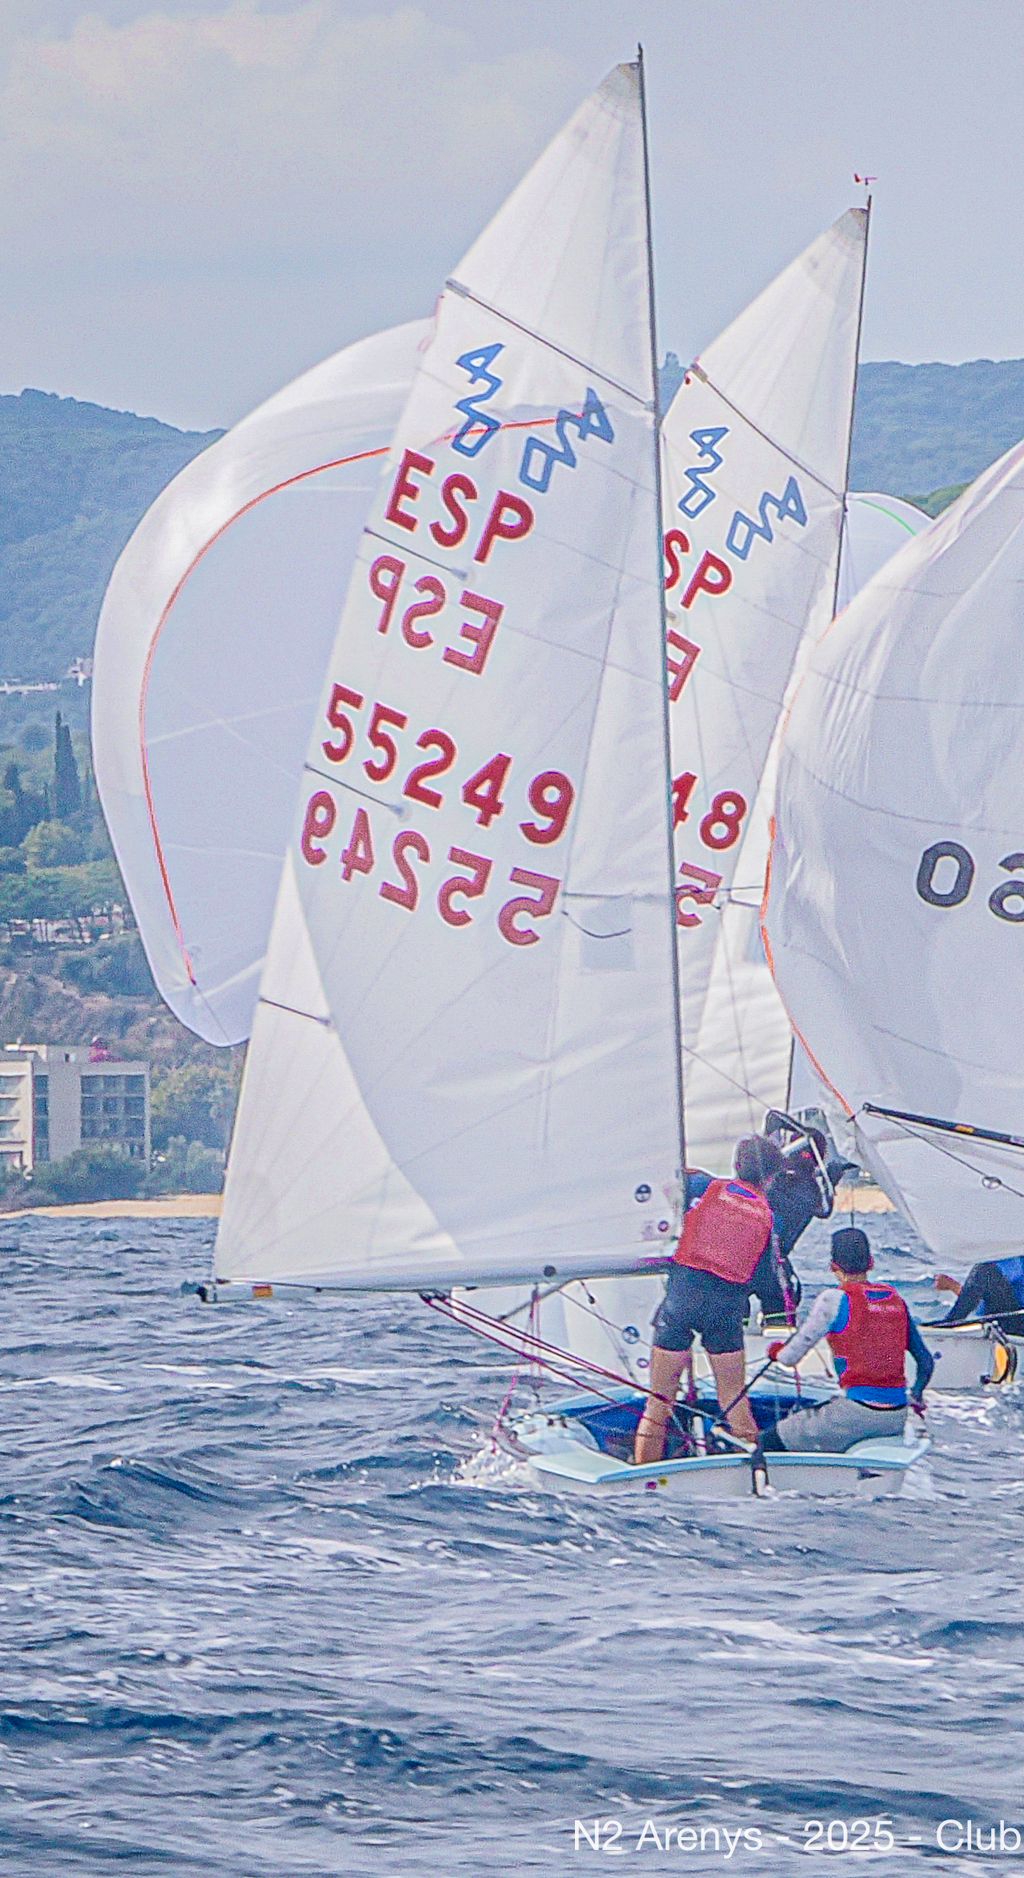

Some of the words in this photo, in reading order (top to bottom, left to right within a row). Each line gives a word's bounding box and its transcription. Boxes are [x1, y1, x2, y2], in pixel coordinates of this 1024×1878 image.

[385, 448, 535, 564] ESP
[663, 528, 733, 610] SP
[322, 683, 576, 846] 55249
